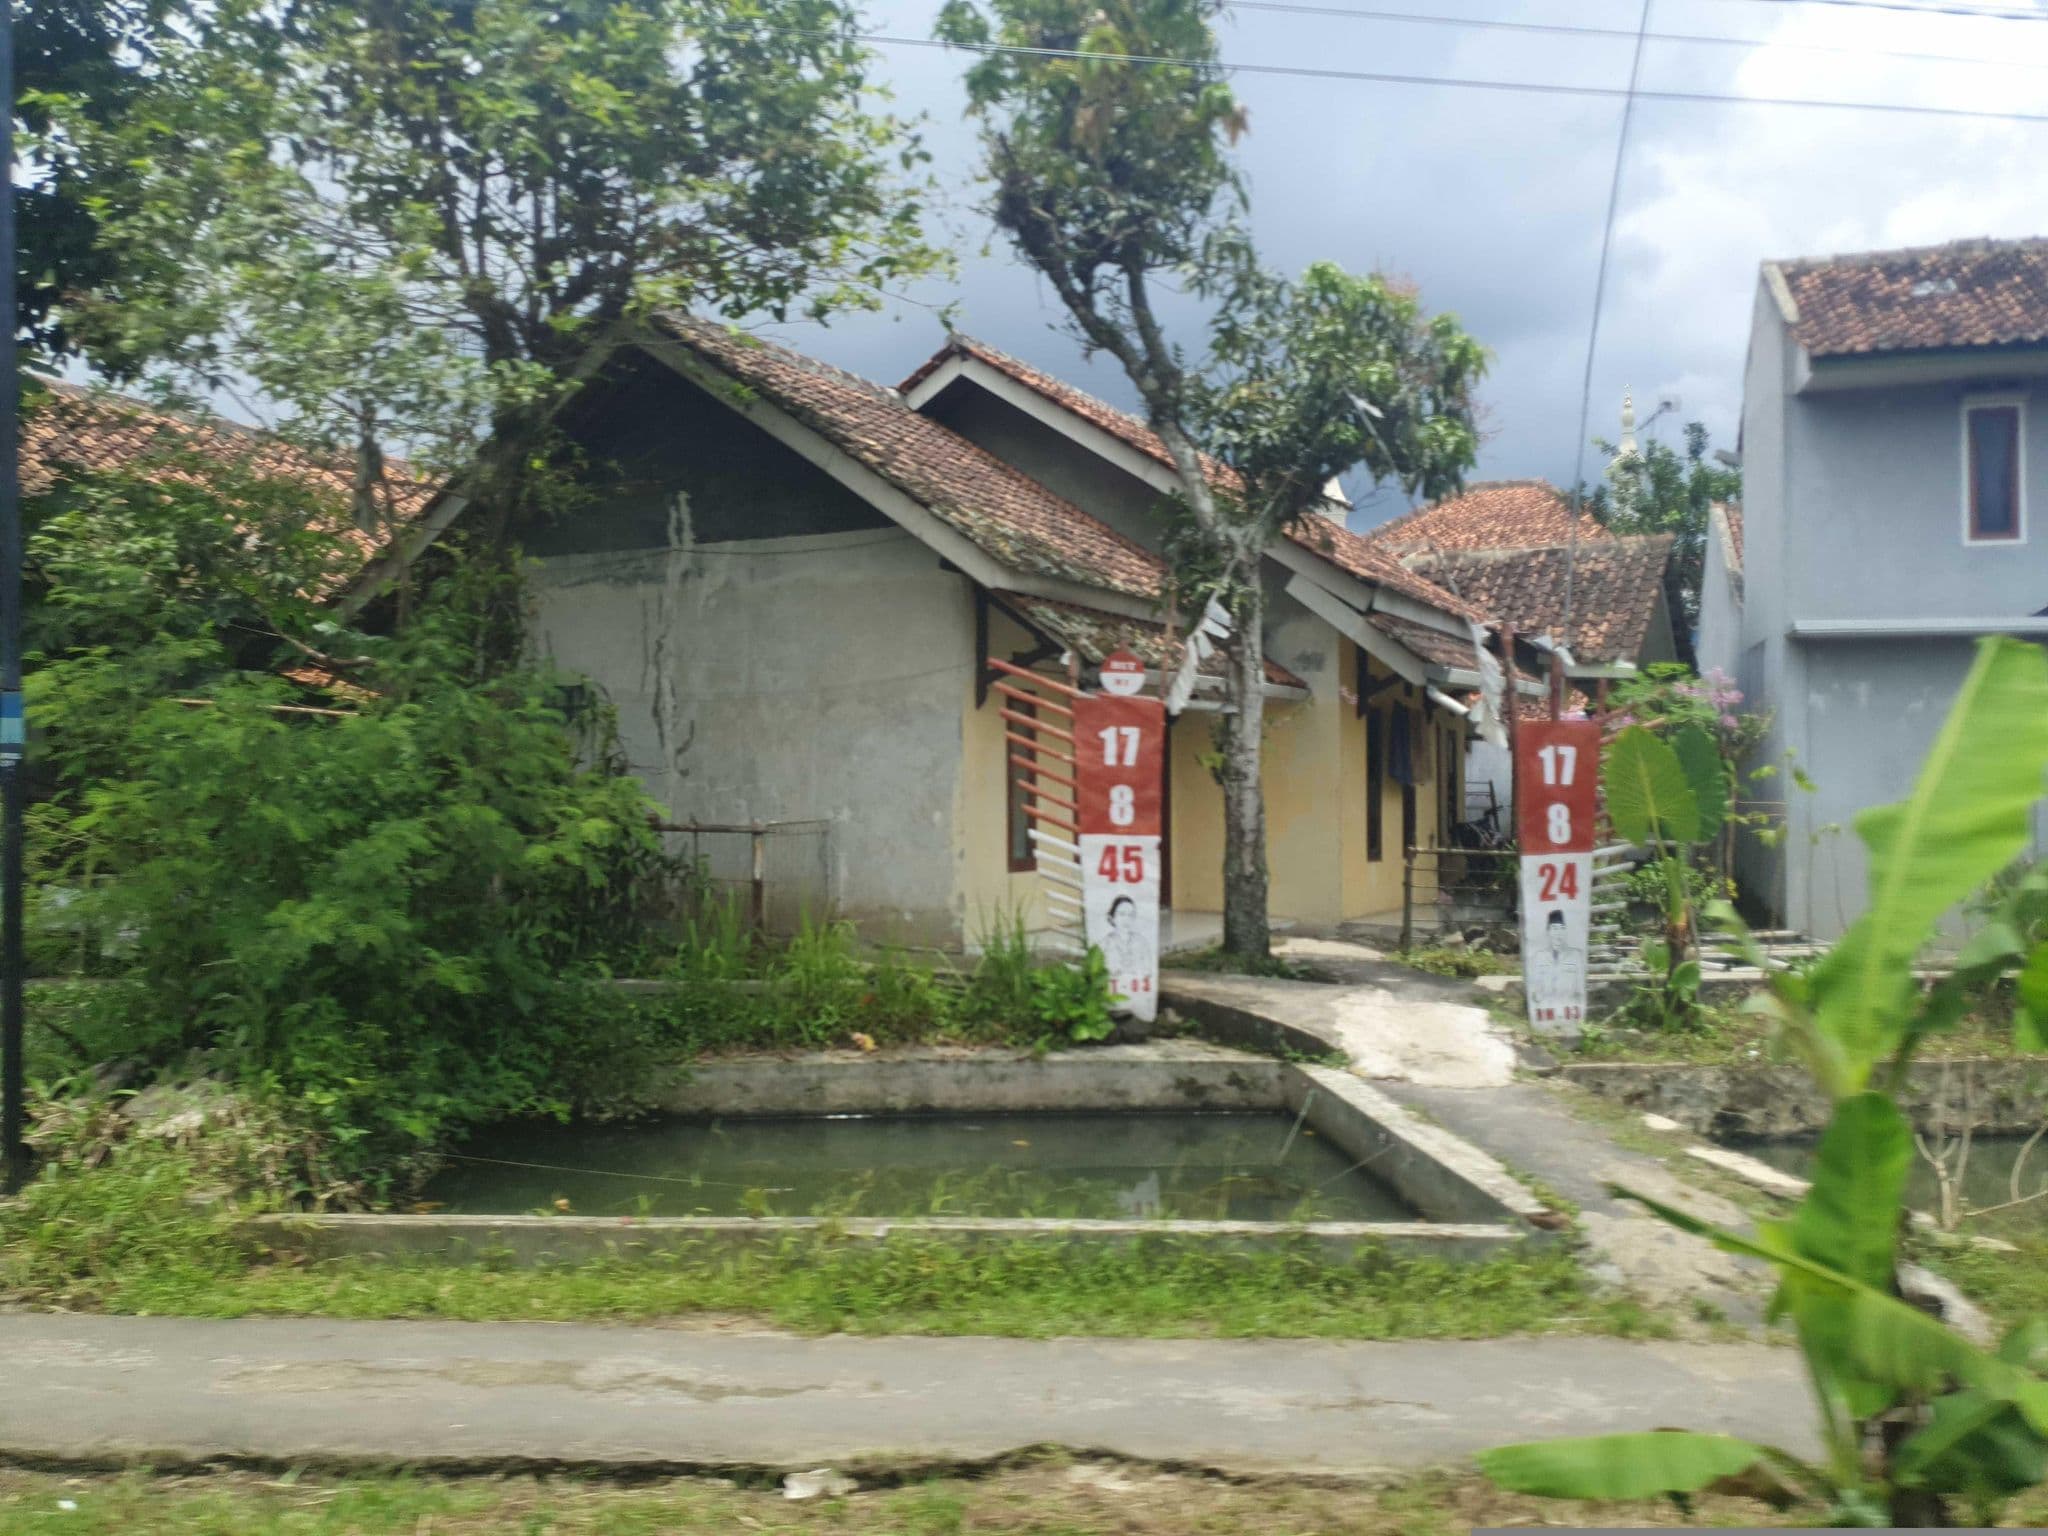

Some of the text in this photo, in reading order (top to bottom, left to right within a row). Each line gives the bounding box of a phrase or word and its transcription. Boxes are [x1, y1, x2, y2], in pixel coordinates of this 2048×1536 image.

[1099, 726, 1140, 766] 17
[1537, 746, 1577, 785] 17
[1110, 785, 1134, 825] 8
[1547, 804, 1572, 845] 8
[1098, 845, 1142, 883] 45
[1538, 865, 1579, 902] 24
